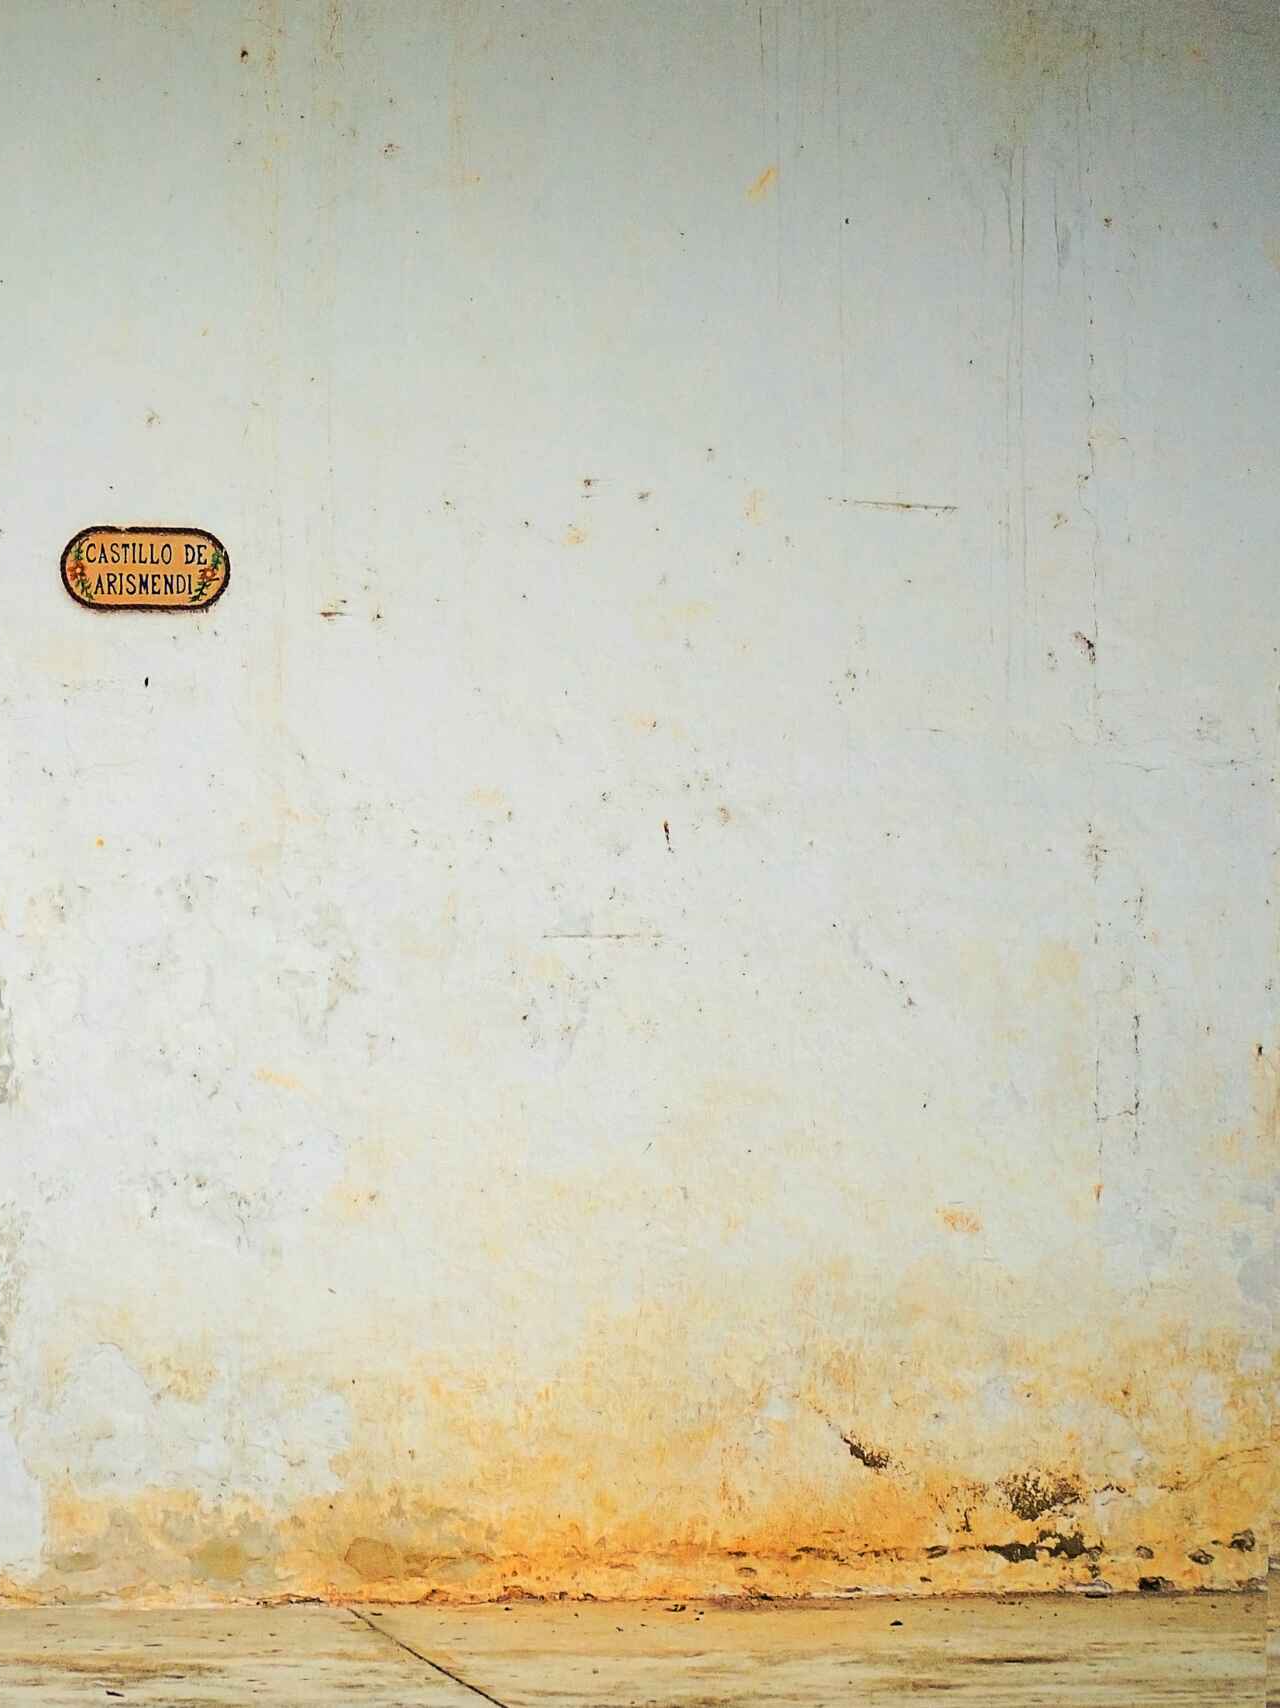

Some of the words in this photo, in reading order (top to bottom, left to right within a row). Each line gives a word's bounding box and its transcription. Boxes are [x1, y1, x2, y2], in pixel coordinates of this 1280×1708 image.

[85, 542, 173, 565] CASTILLO
[184, 543, 208, 566] DE
[94, 572, 193, 596] ARISMENDI
